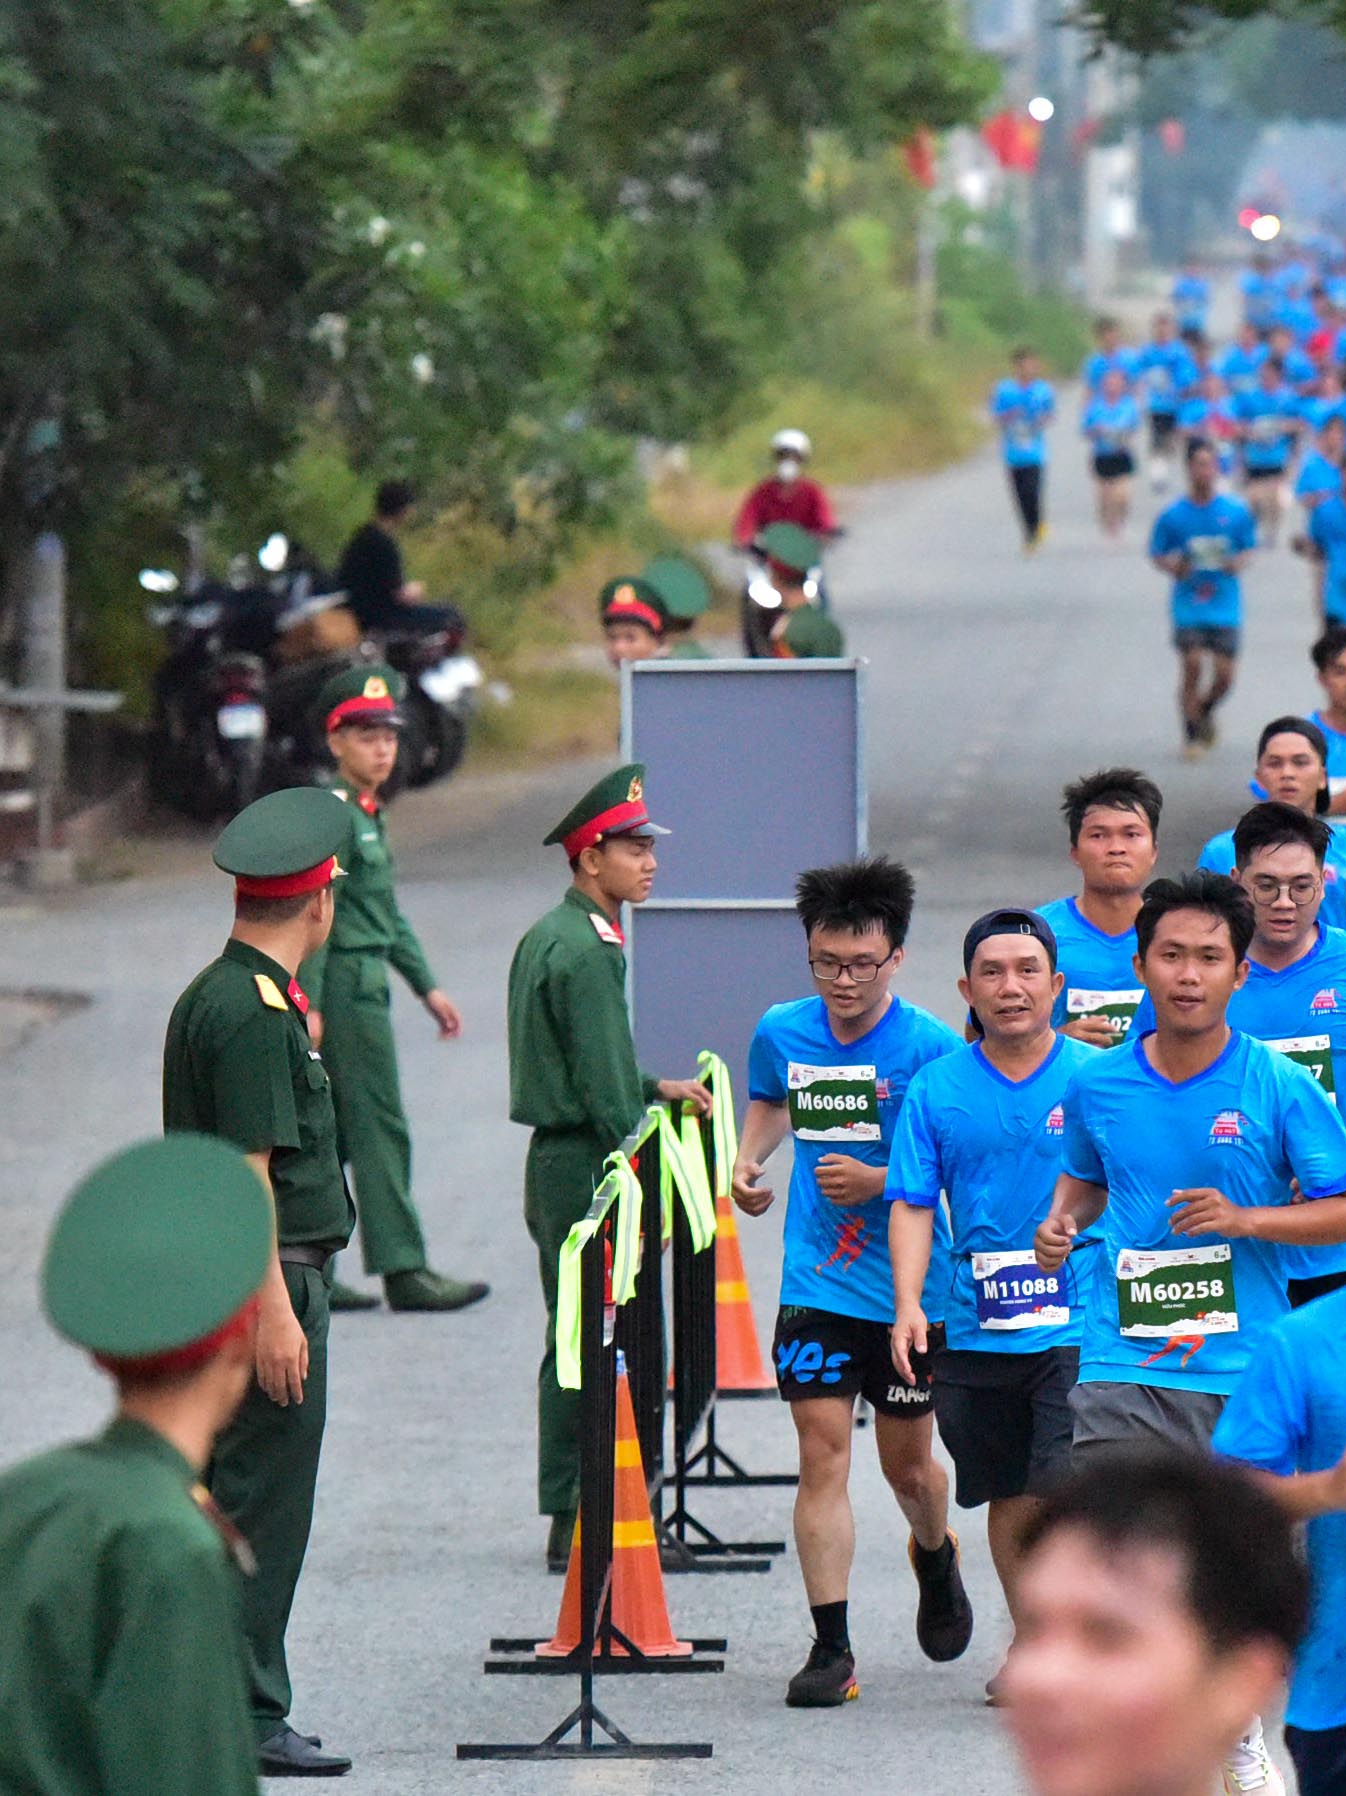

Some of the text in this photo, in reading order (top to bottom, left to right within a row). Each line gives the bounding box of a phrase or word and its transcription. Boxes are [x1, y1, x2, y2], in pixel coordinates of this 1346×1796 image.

[797, 1091, 868, 1111] M60686
[983, 1277, 1059, 1299] M11088
[1130, 1279, 1225, 1303] M60258
